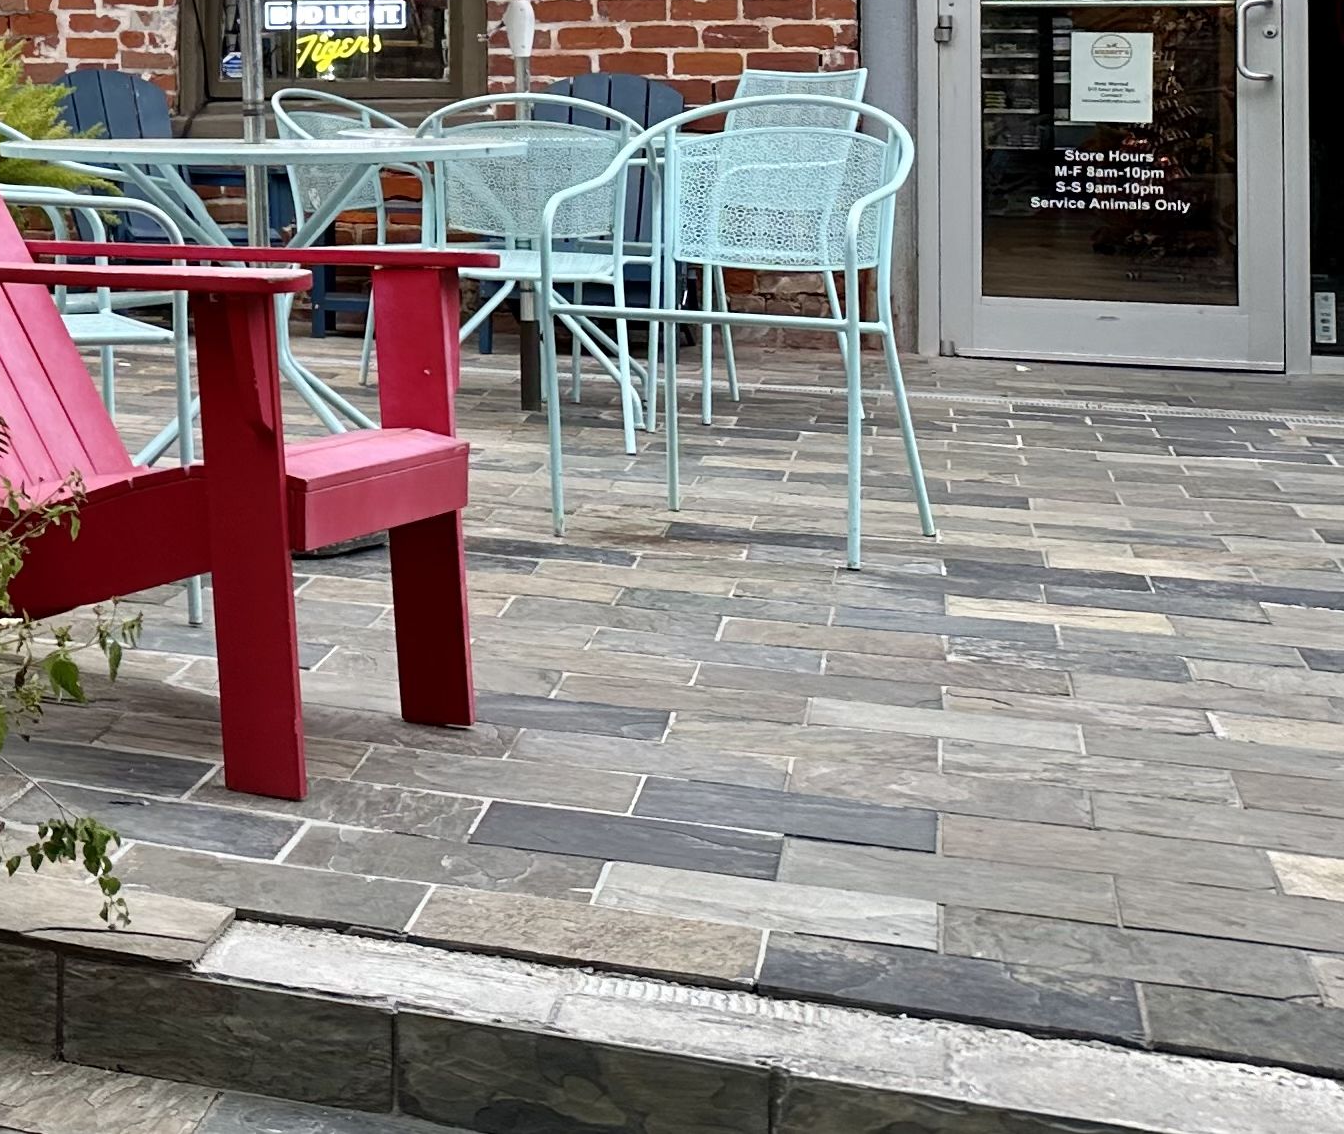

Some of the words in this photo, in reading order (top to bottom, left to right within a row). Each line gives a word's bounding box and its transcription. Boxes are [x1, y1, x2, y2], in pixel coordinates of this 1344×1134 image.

[296, 33, 382, 73] Tigers
[1064, 149, 1105, 162] Store
[1109, 150, 1154, 163] Hours
[1054, 165, 1082, 177] M-F
[1086, 165, 1165, 181] 8am-10pm
[1055, 181, 1082, 194] S-S
[1085, 181, 1164, 197] 9am-10pm
[1030, 196, 1085, 209] Service
[1088, 197, 1151, 211] Animals
[1154, 199, 1192, 214] Only
